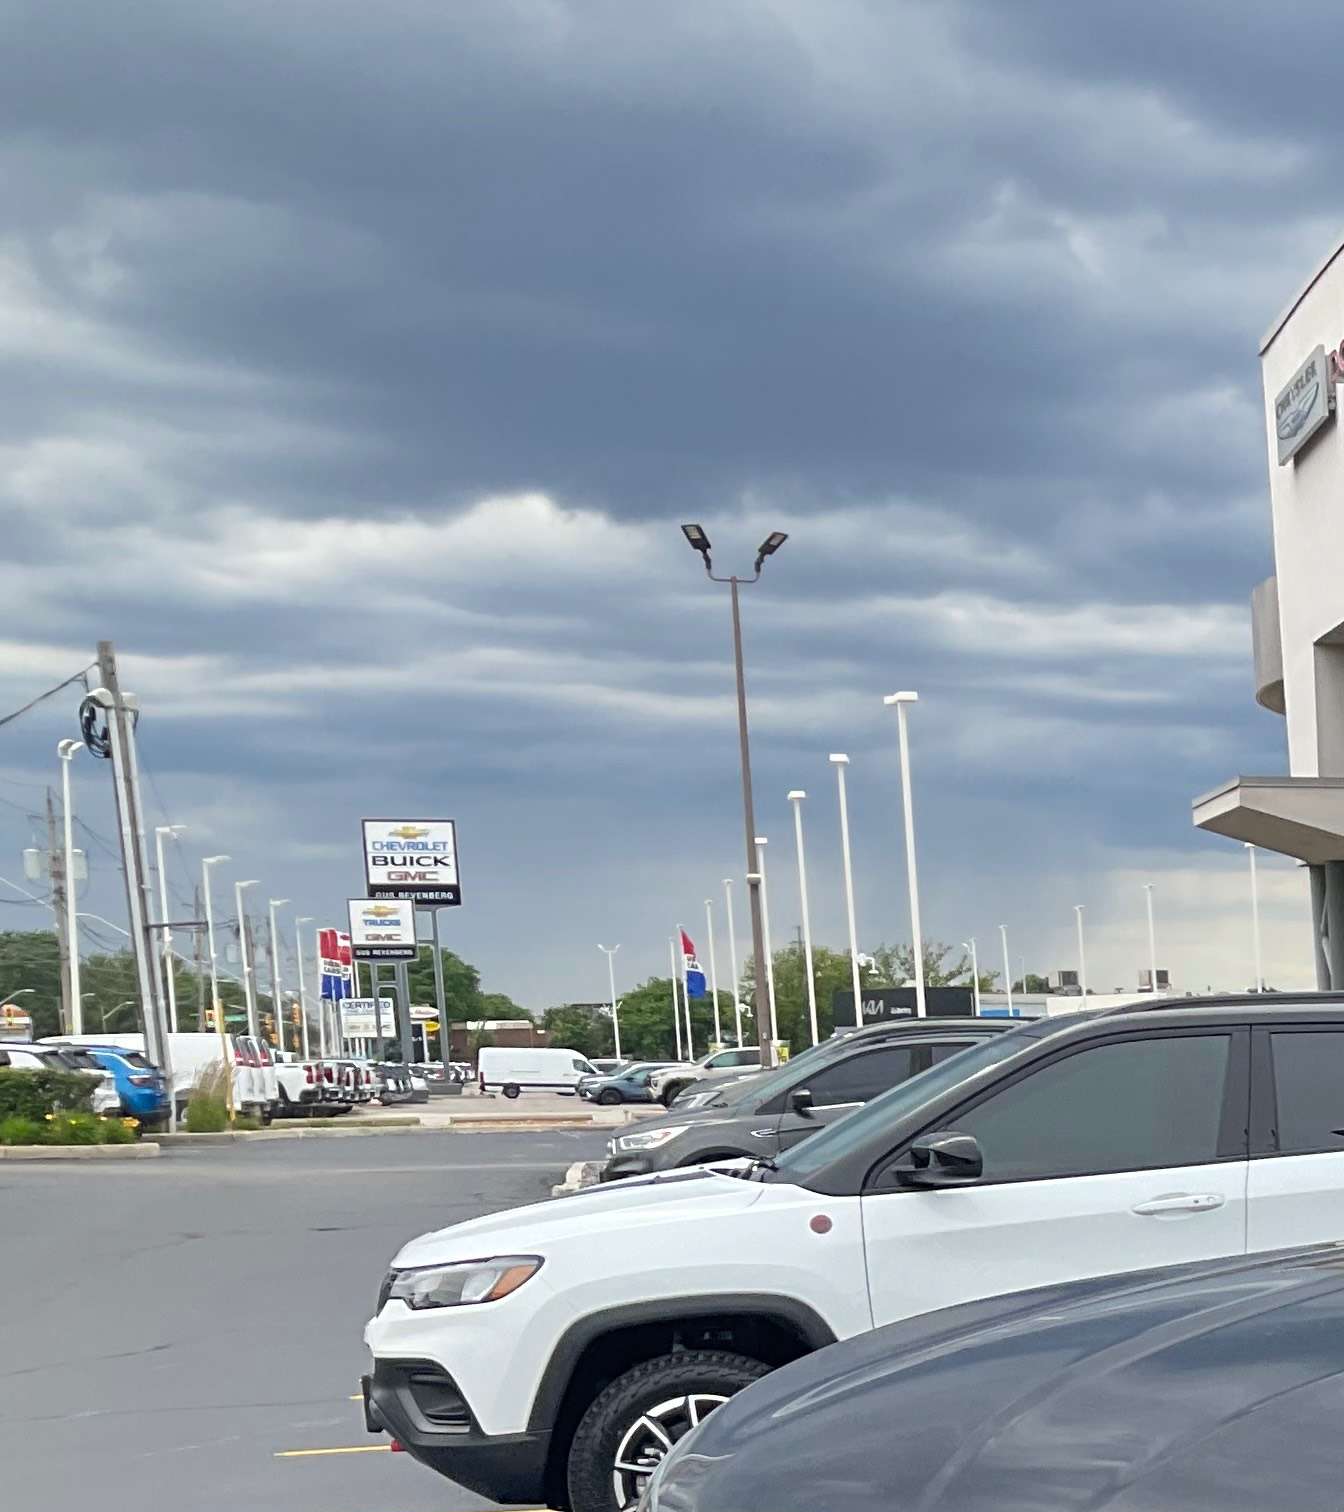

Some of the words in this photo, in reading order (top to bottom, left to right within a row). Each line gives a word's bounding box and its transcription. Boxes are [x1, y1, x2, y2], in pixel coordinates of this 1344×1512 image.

[371, 841, 449, 851] CHEVROLET
[371, 855, 451, 867] BUICK
[387, 871, 439, 881] GMC
[343, 1001, 391, 1009] CERTIFED
